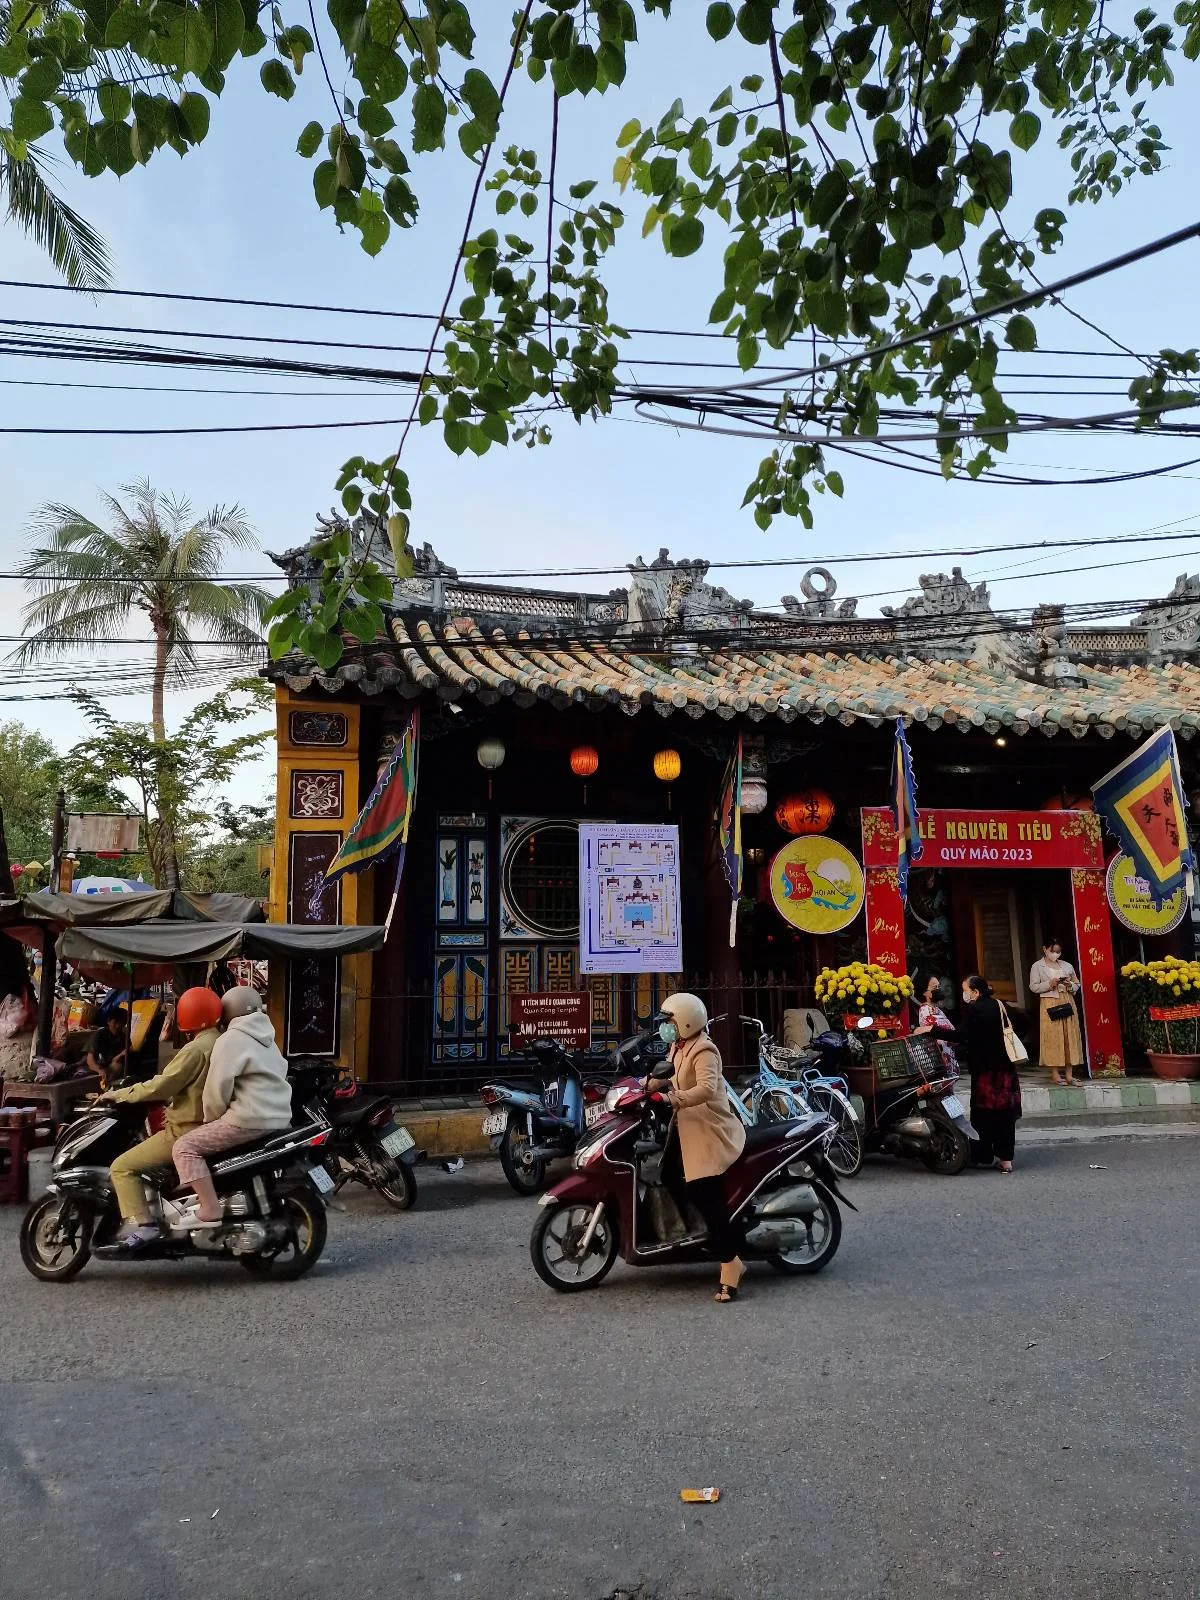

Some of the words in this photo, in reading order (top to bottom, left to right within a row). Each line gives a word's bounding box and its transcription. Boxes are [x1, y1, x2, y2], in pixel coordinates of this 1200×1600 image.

[918, 814, 937, 839] LỄ
[946, 819, 1008, 840] NGUYÊN
[1017, 820, 1052, 841] TIÊU
[940, 844, 967, 860] QUÝ
[969, 845, 999, 860] MÃO
[1002, 848, 1033, 860] 2023
